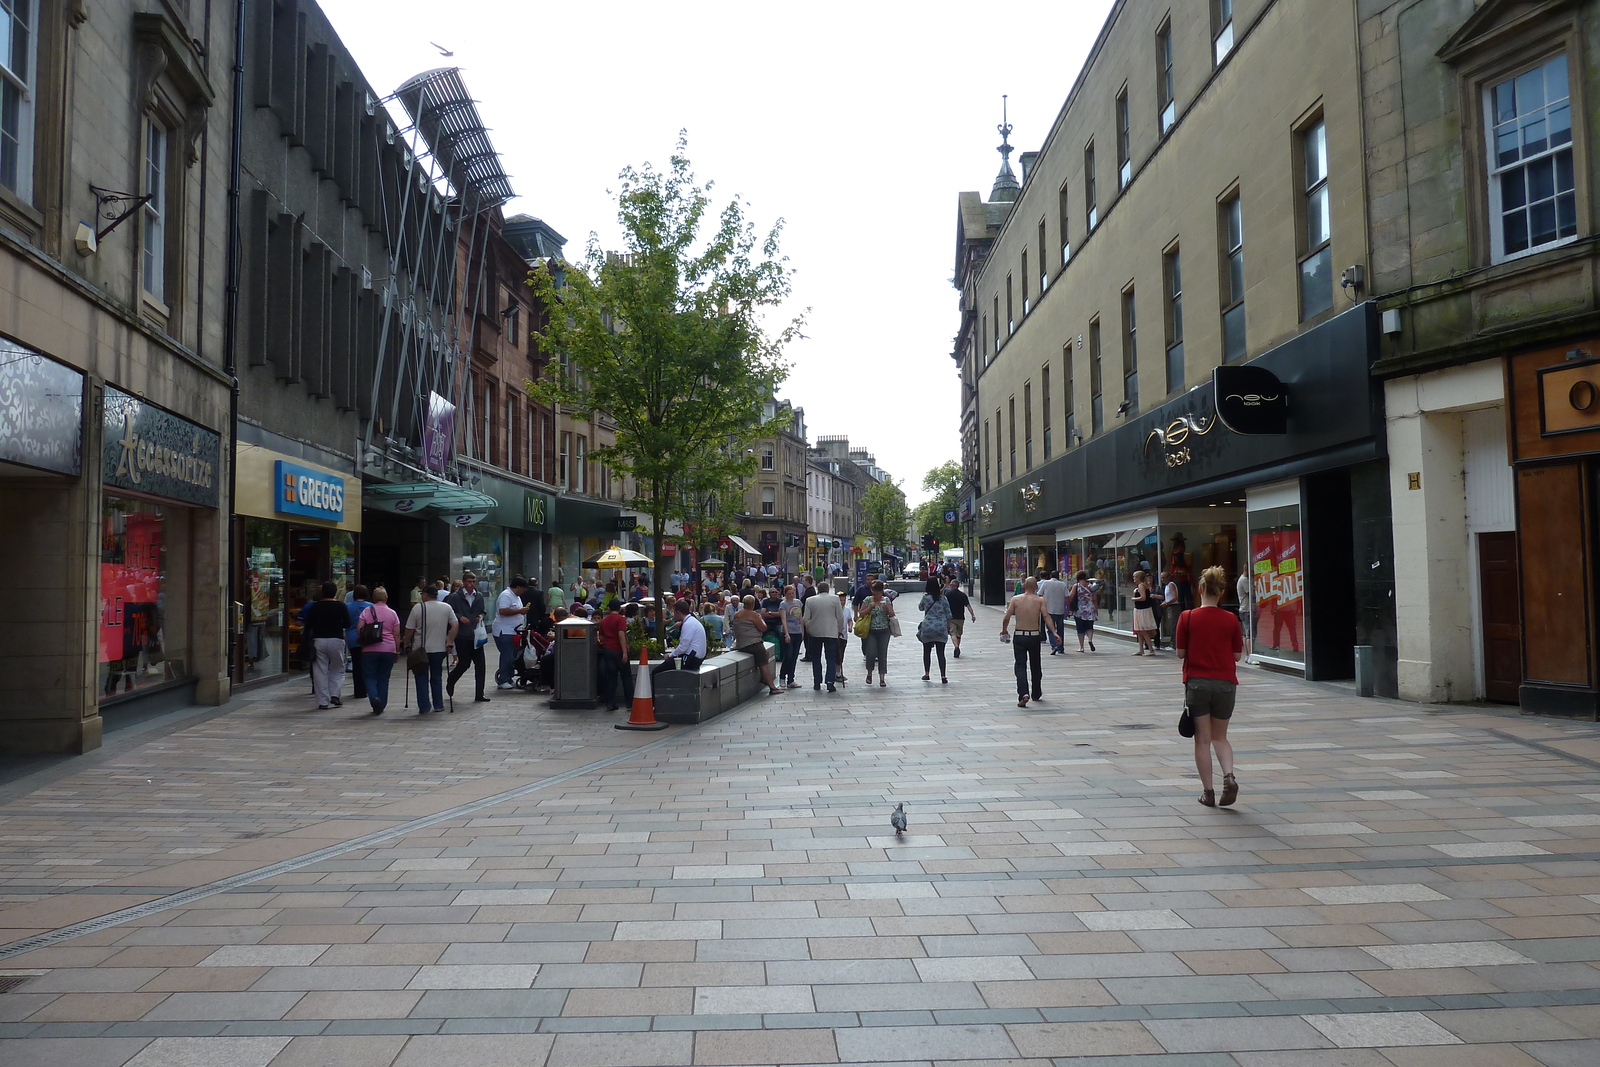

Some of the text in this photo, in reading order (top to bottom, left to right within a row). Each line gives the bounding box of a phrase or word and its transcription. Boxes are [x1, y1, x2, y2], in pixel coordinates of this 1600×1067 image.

[1569, 381, 1596, 411] O
[298, 475, 343, 513] GREGGS
[527, 496, 545, 525] M&S
[617, 519, 636, 529] M&S
[1255, 571, 1280, 603] ALE
